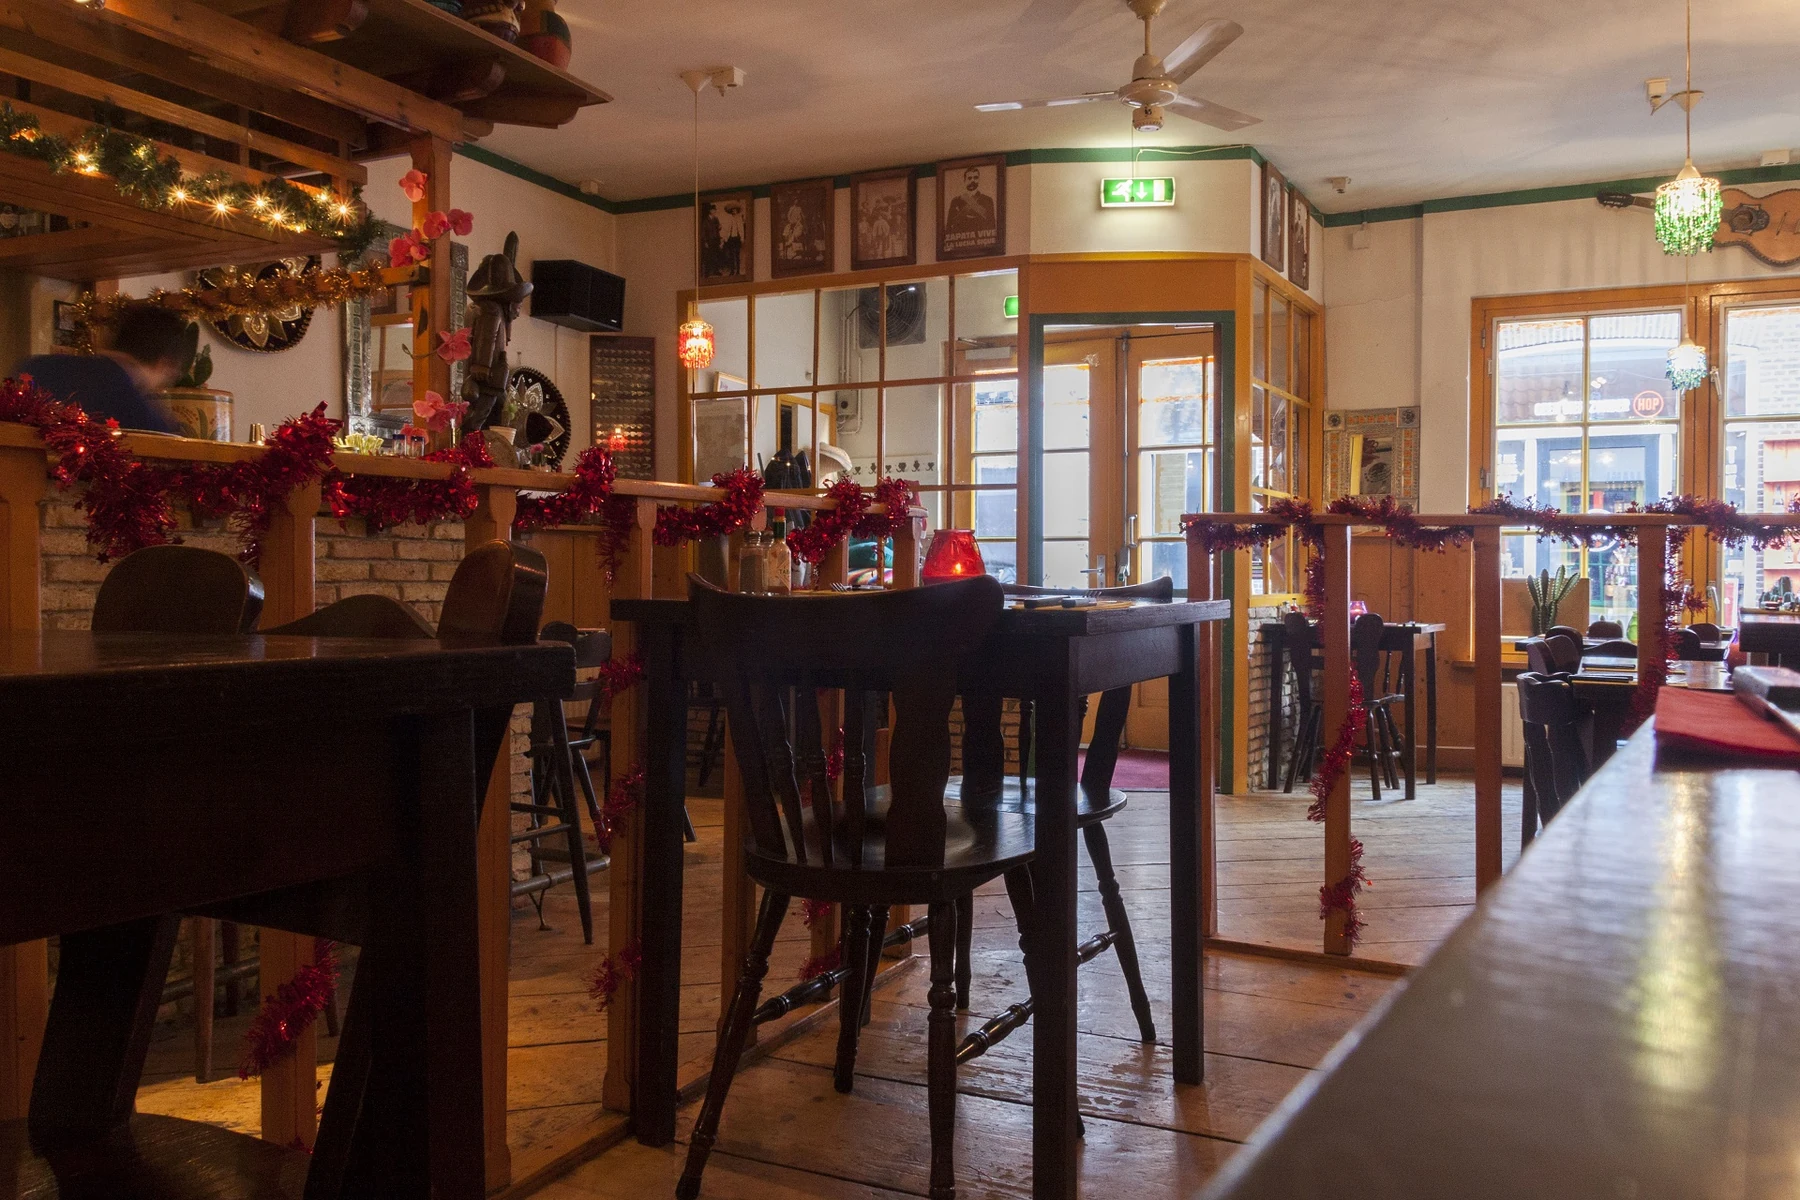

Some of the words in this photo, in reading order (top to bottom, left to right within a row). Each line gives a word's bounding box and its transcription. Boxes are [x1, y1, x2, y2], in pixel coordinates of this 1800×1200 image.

[945, 231, 976, 241] ZAPATA
[977, 229, 997, 238] VIVE
[1637, 398, 1660, 411] HOP
